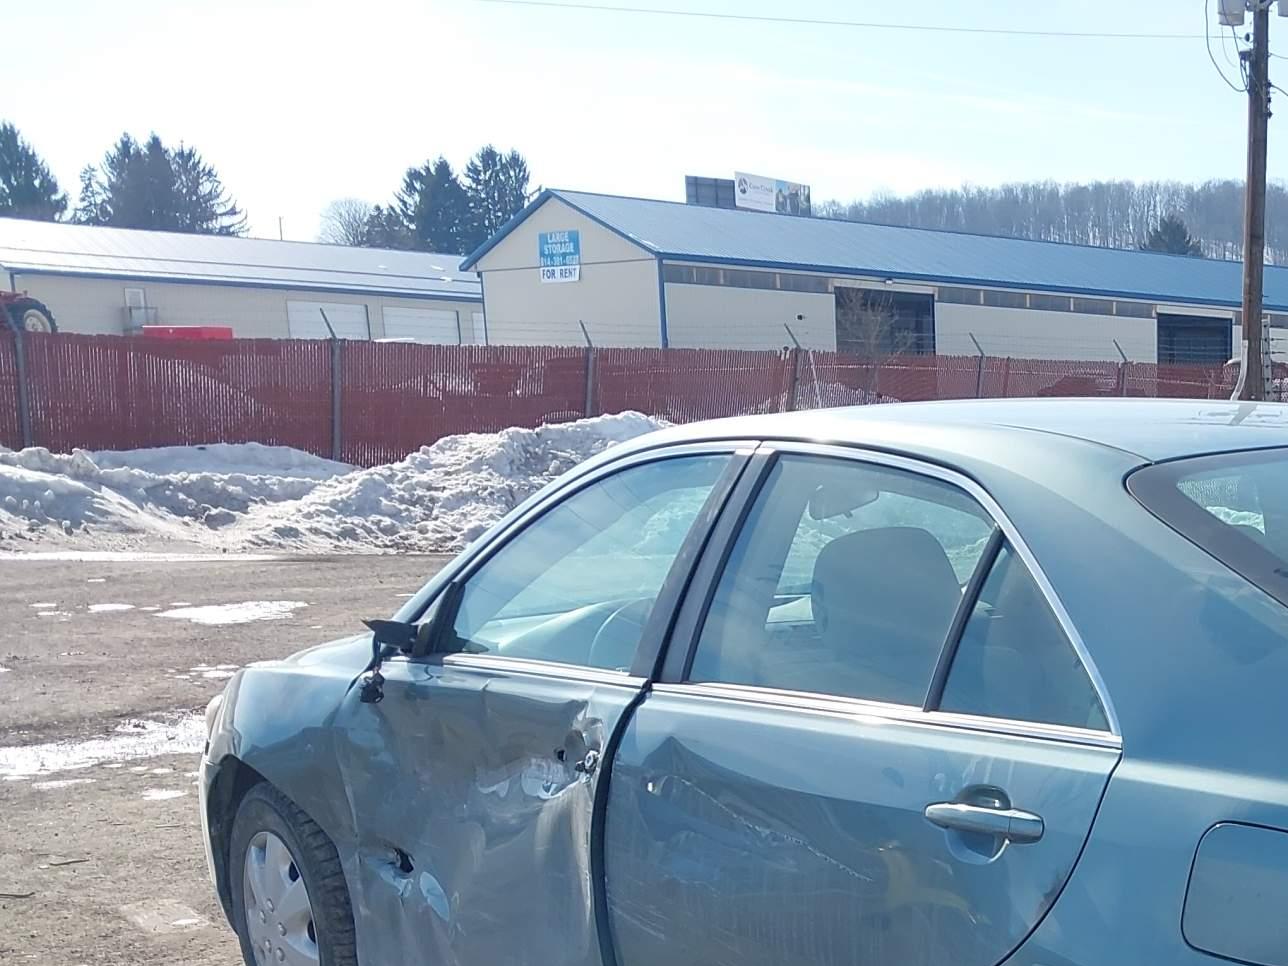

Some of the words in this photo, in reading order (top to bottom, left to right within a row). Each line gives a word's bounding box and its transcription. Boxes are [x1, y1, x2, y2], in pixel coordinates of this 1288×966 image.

[547, 231, 569, 243] LARGE
[543, 242, 575, 255] STORAGE
[542, 268, 556, 280] FOR
[560, 267, 577, 279] RENT
